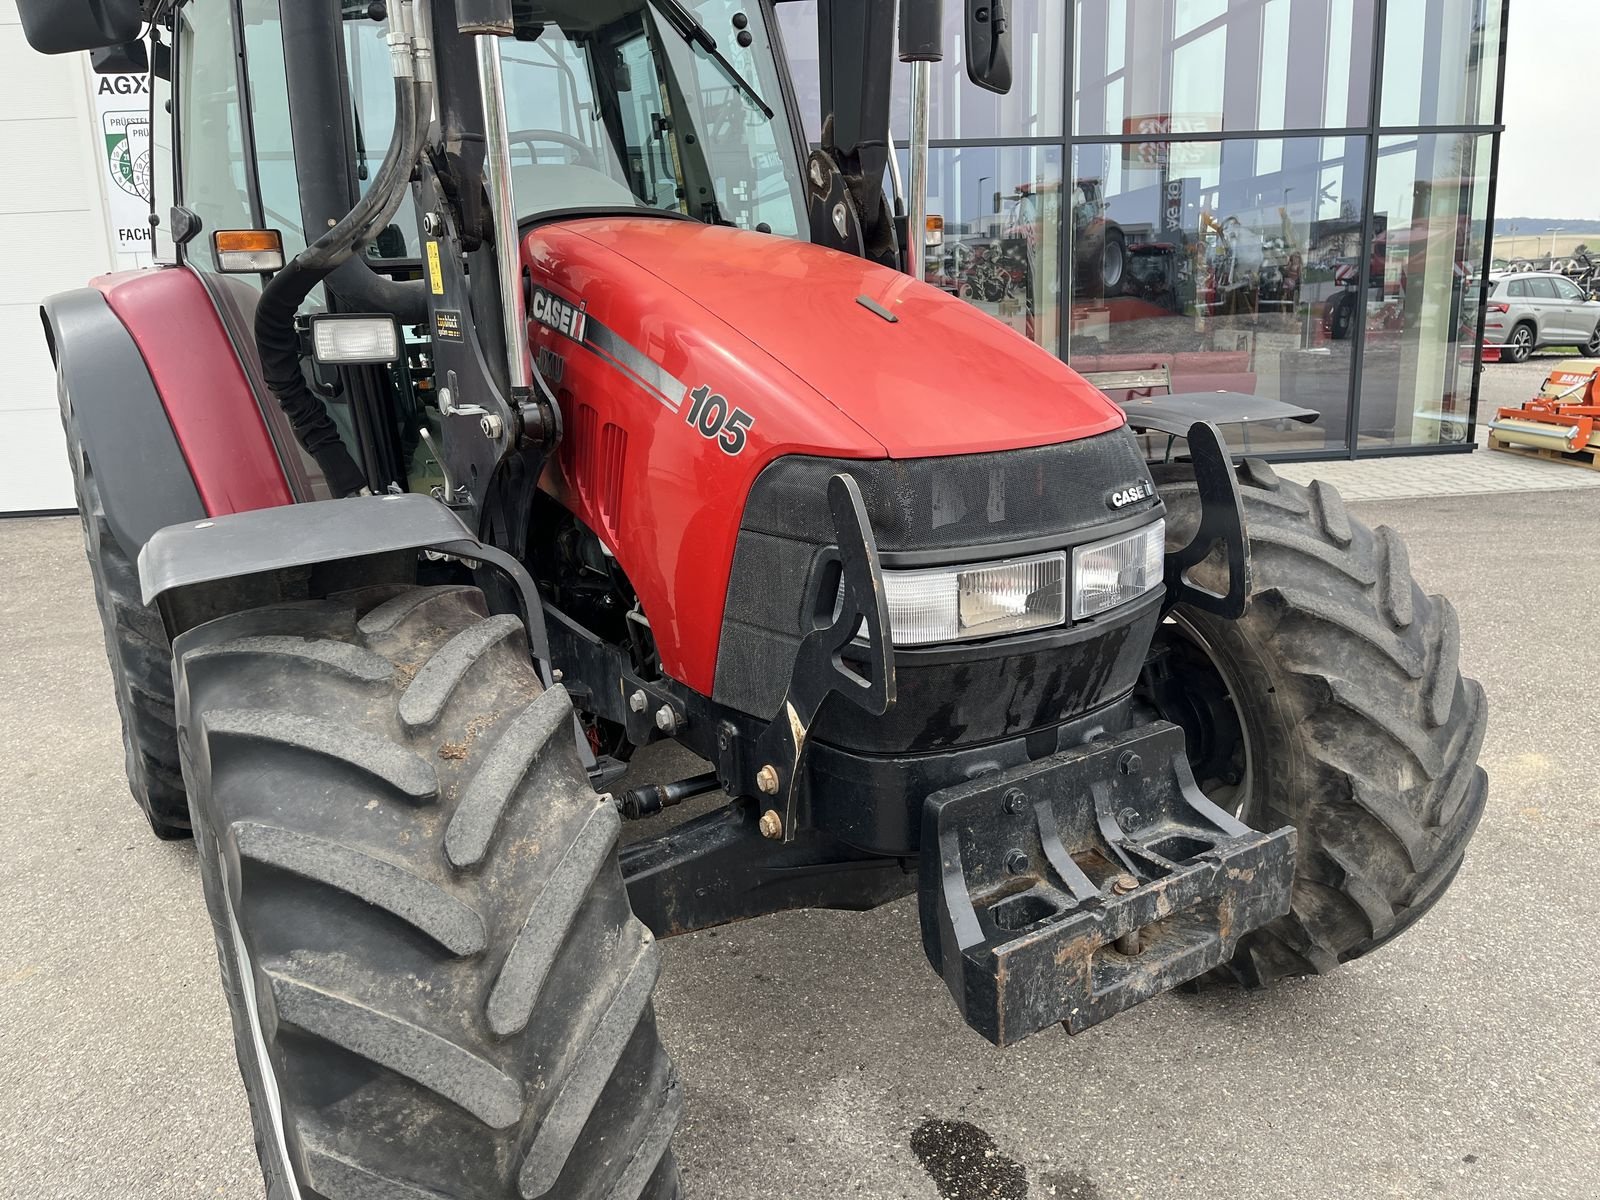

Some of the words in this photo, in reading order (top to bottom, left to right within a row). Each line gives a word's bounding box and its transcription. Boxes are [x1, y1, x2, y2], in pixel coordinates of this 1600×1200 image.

[98, 75, 150, 95] AGX
[119, 228, 151, 241] FACH
[533, 292, 571, 334] CASE
[685, 384, 755, 456] 105
[1112, 486, 1145, 507] CASE
